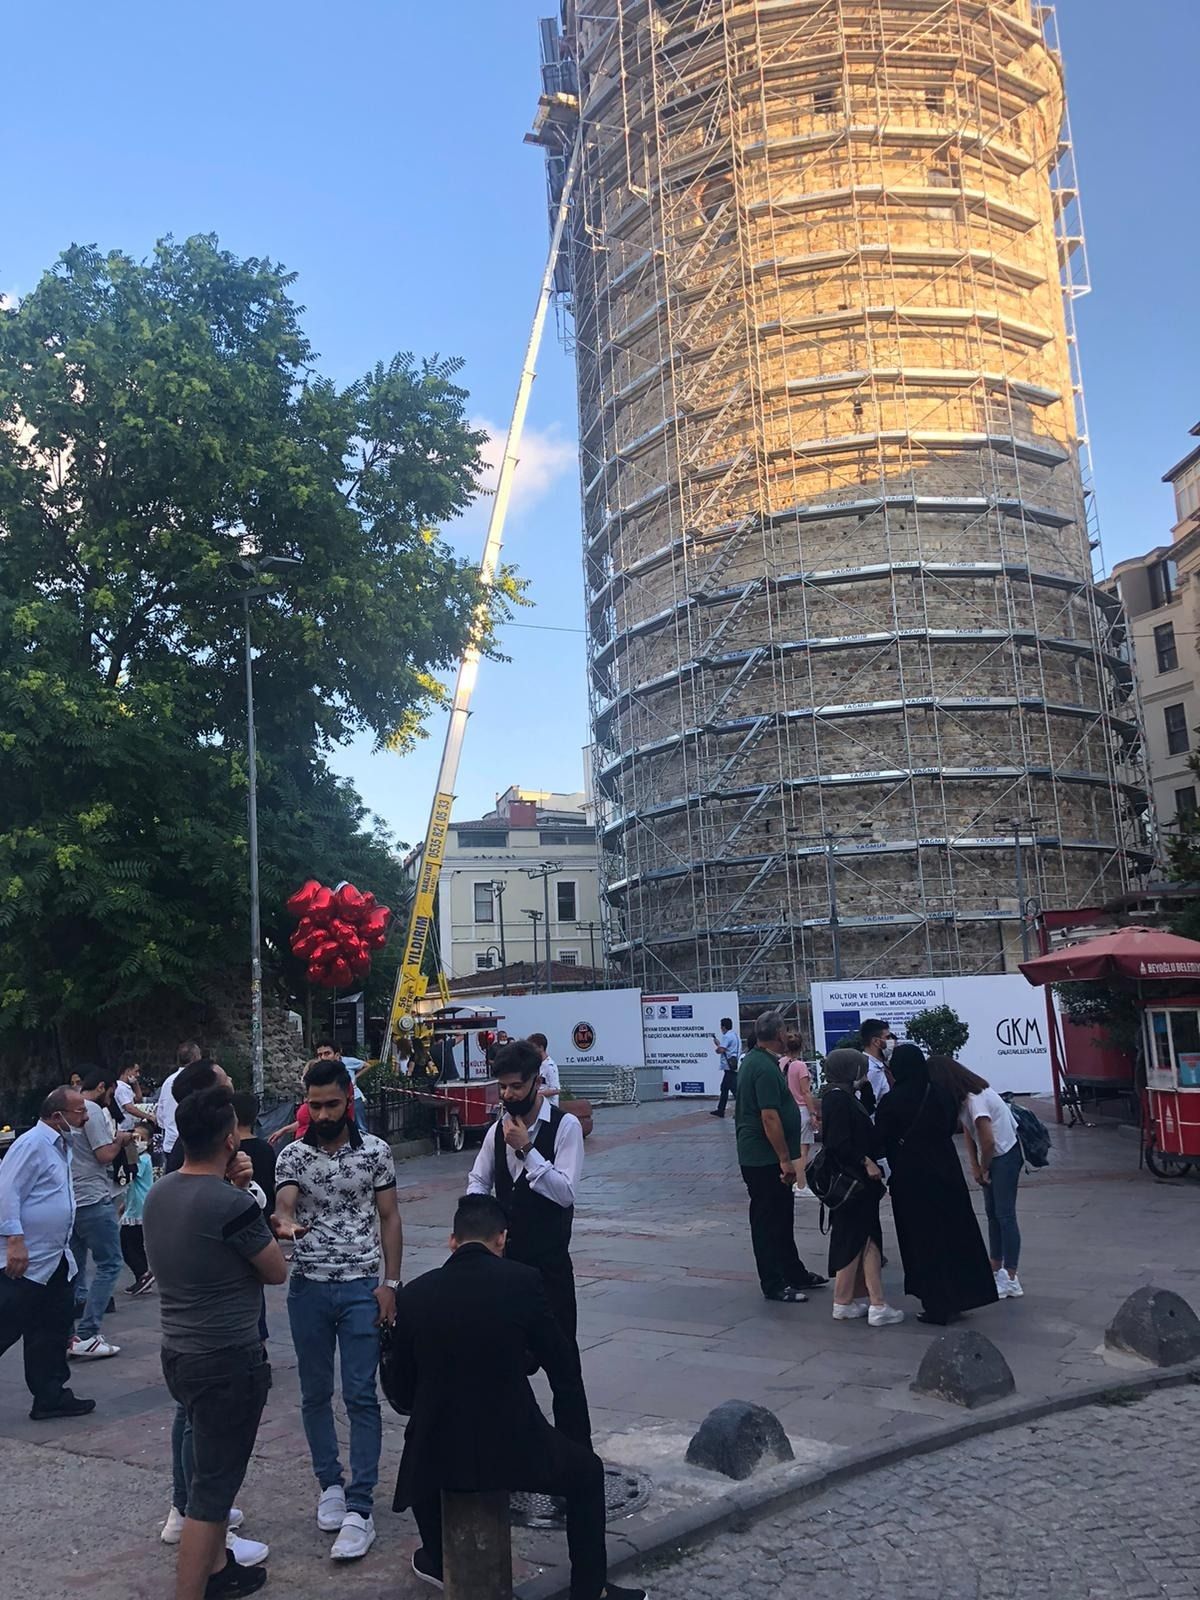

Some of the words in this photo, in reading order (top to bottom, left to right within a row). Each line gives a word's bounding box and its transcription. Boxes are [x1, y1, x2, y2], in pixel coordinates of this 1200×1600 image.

[438, 799, 450, 810] 33
[435, 810, 448, 822] 05
[432, 822, 446, 838] 821
[428, 839, 442, 859] 0535
[407, 915, 429, 965] YILDIRIM
[829, 992, 857, 1000] KÜLTÜR
[870, 990, 896, 998] TURİZM
[897, 990, 936, 998] BAKANLIĞI
[398, 997, 407, 1008] 56
[576, 1055, 604, 1063] VAKIFLAR
